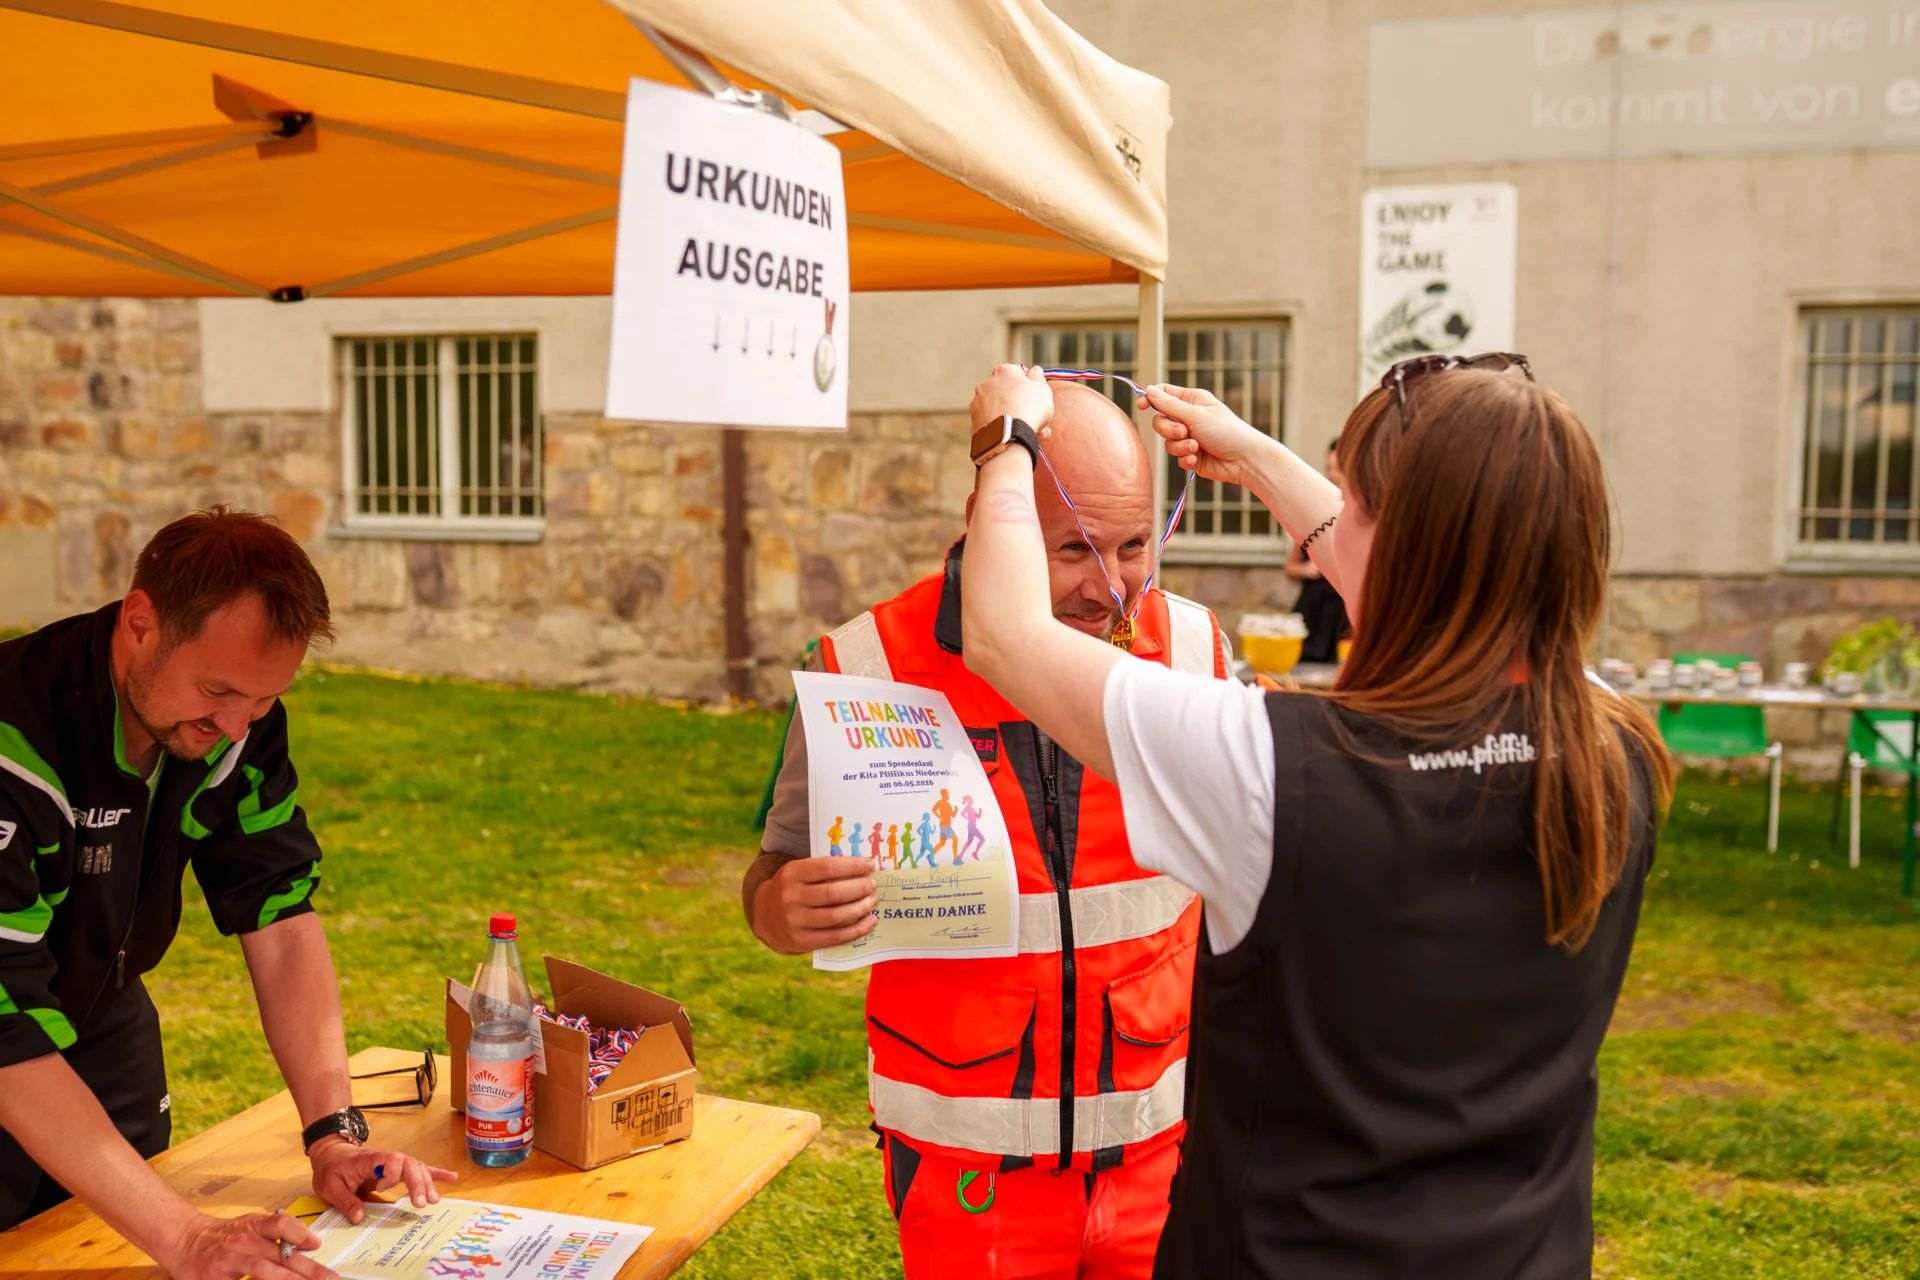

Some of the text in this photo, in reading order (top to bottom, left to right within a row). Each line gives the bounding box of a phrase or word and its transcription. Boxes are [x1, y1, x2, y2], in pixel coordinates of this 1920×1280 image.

[1531, 85, 1732, 131] kommt
[1752, 81, 1859, 122] von
[666, 153, 832, 230] URKUNDEN
[1378, 200, 1453, 225] ENJOY
[677, 238, 824, 298] AUSGABE
[1377, 249, 1447, 273] GAME
[824, 701, 940, 727] TEILNAHME
[845, 727, 944, 750] URKUNDE
[843, 773, 857, 781] der
[860, 772, 878, 780] Kita
[888, 760, 934, 769] Spendenlauf
[883, 908, 934, 919] SAGEN
[937, 904, 986, 918] DANKE
[478, 1122, 493, 1130] PUR
[536, 1231, 591, 1280] URKUNDE
[561, 1231, 619, 1280] TEILNAHM
